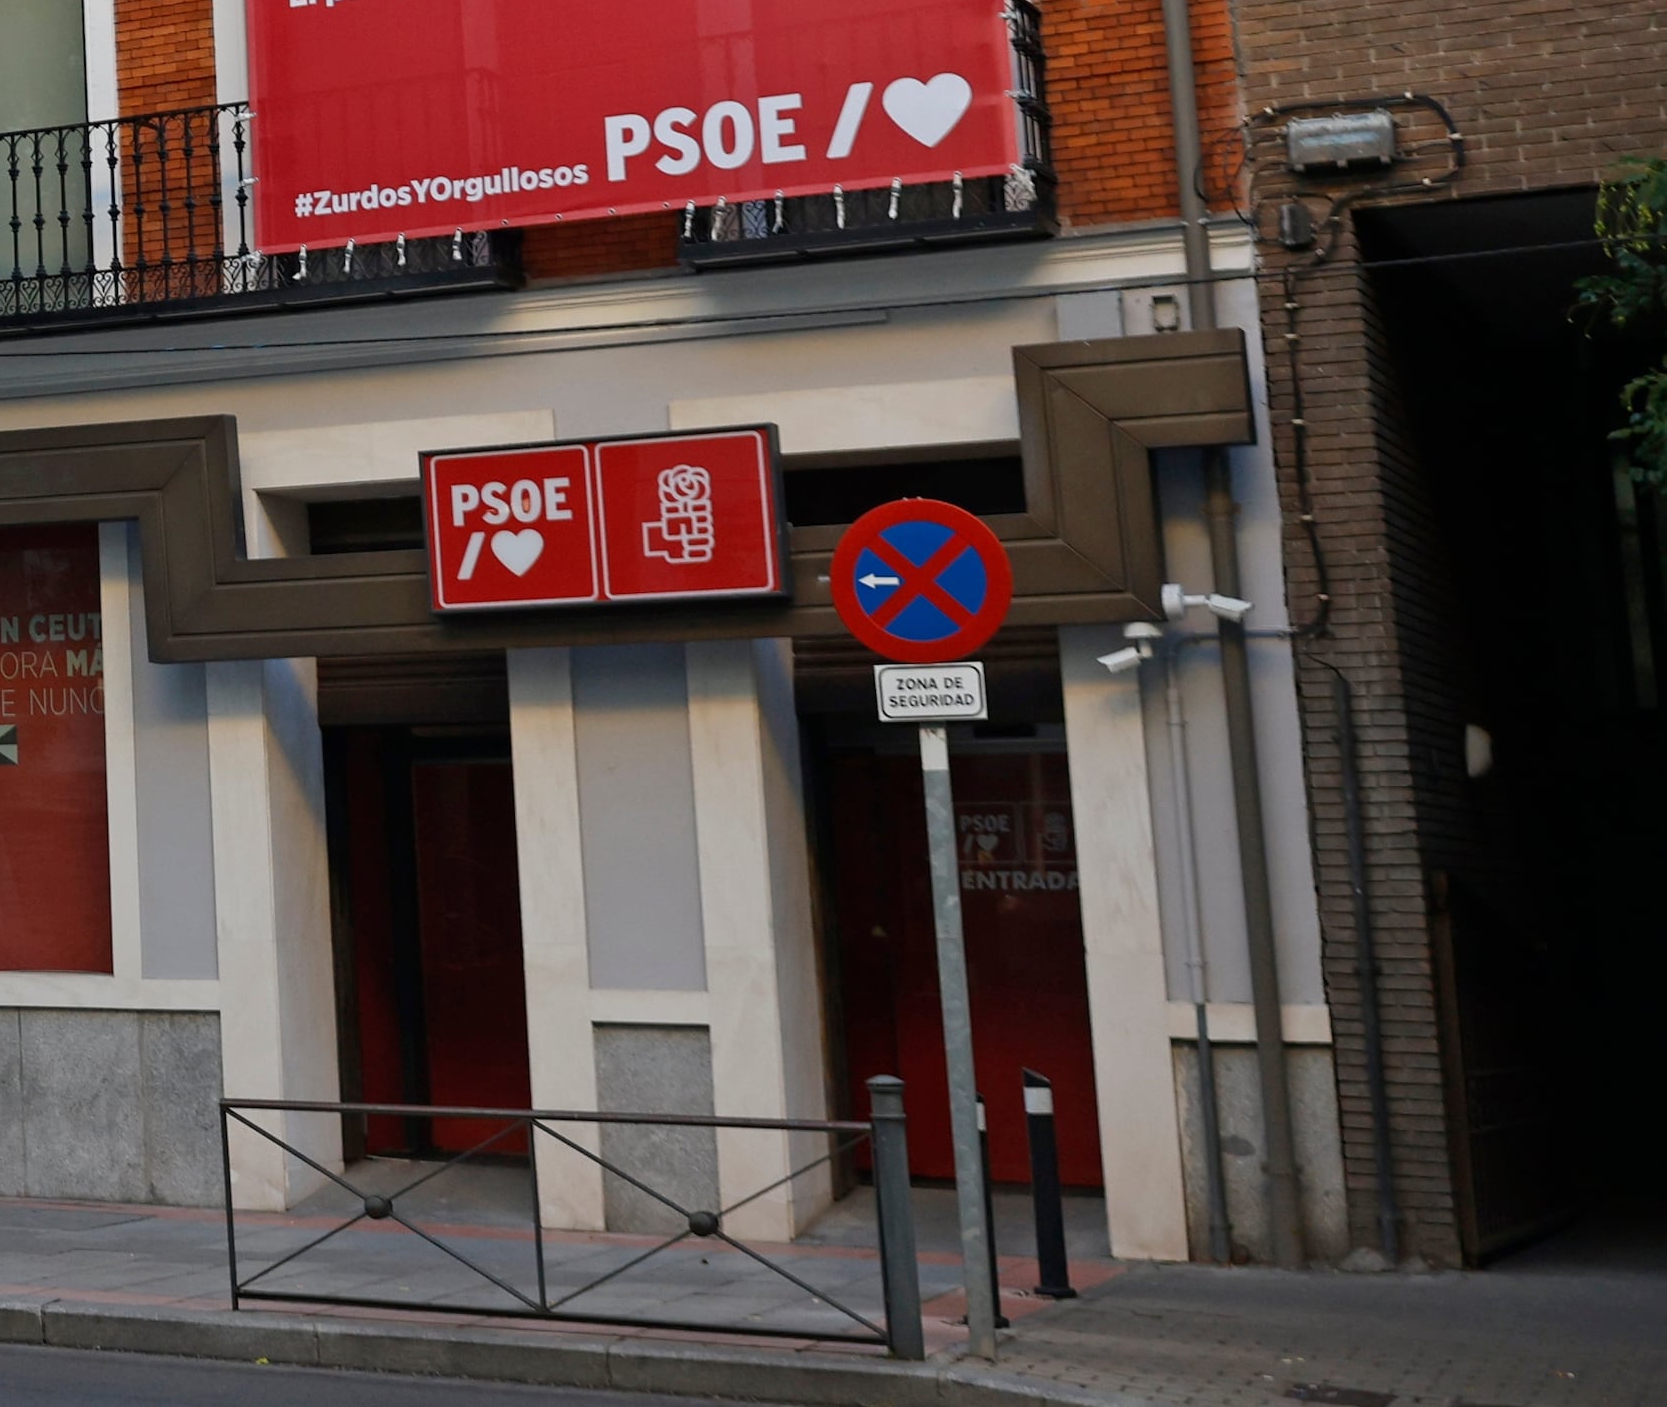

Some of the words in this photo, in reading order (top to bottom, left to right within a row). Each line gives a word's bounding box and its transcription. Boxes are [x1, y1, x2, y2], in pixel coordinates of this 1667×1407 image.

[295, 164, 589, 217] #ZurdosYOrgullosos
[605, 93, 805, 181] PSOE
[451, 477, 572, 527] PSOE
[896, 677, 938, 691] ZONA
[943, 676, 964, 689] DE
[889, 693, 975, 708] SEGURIDAD
[959, 814, 1011, 833] PSOE
[961, 870, 1078, 890] ENTRADA
